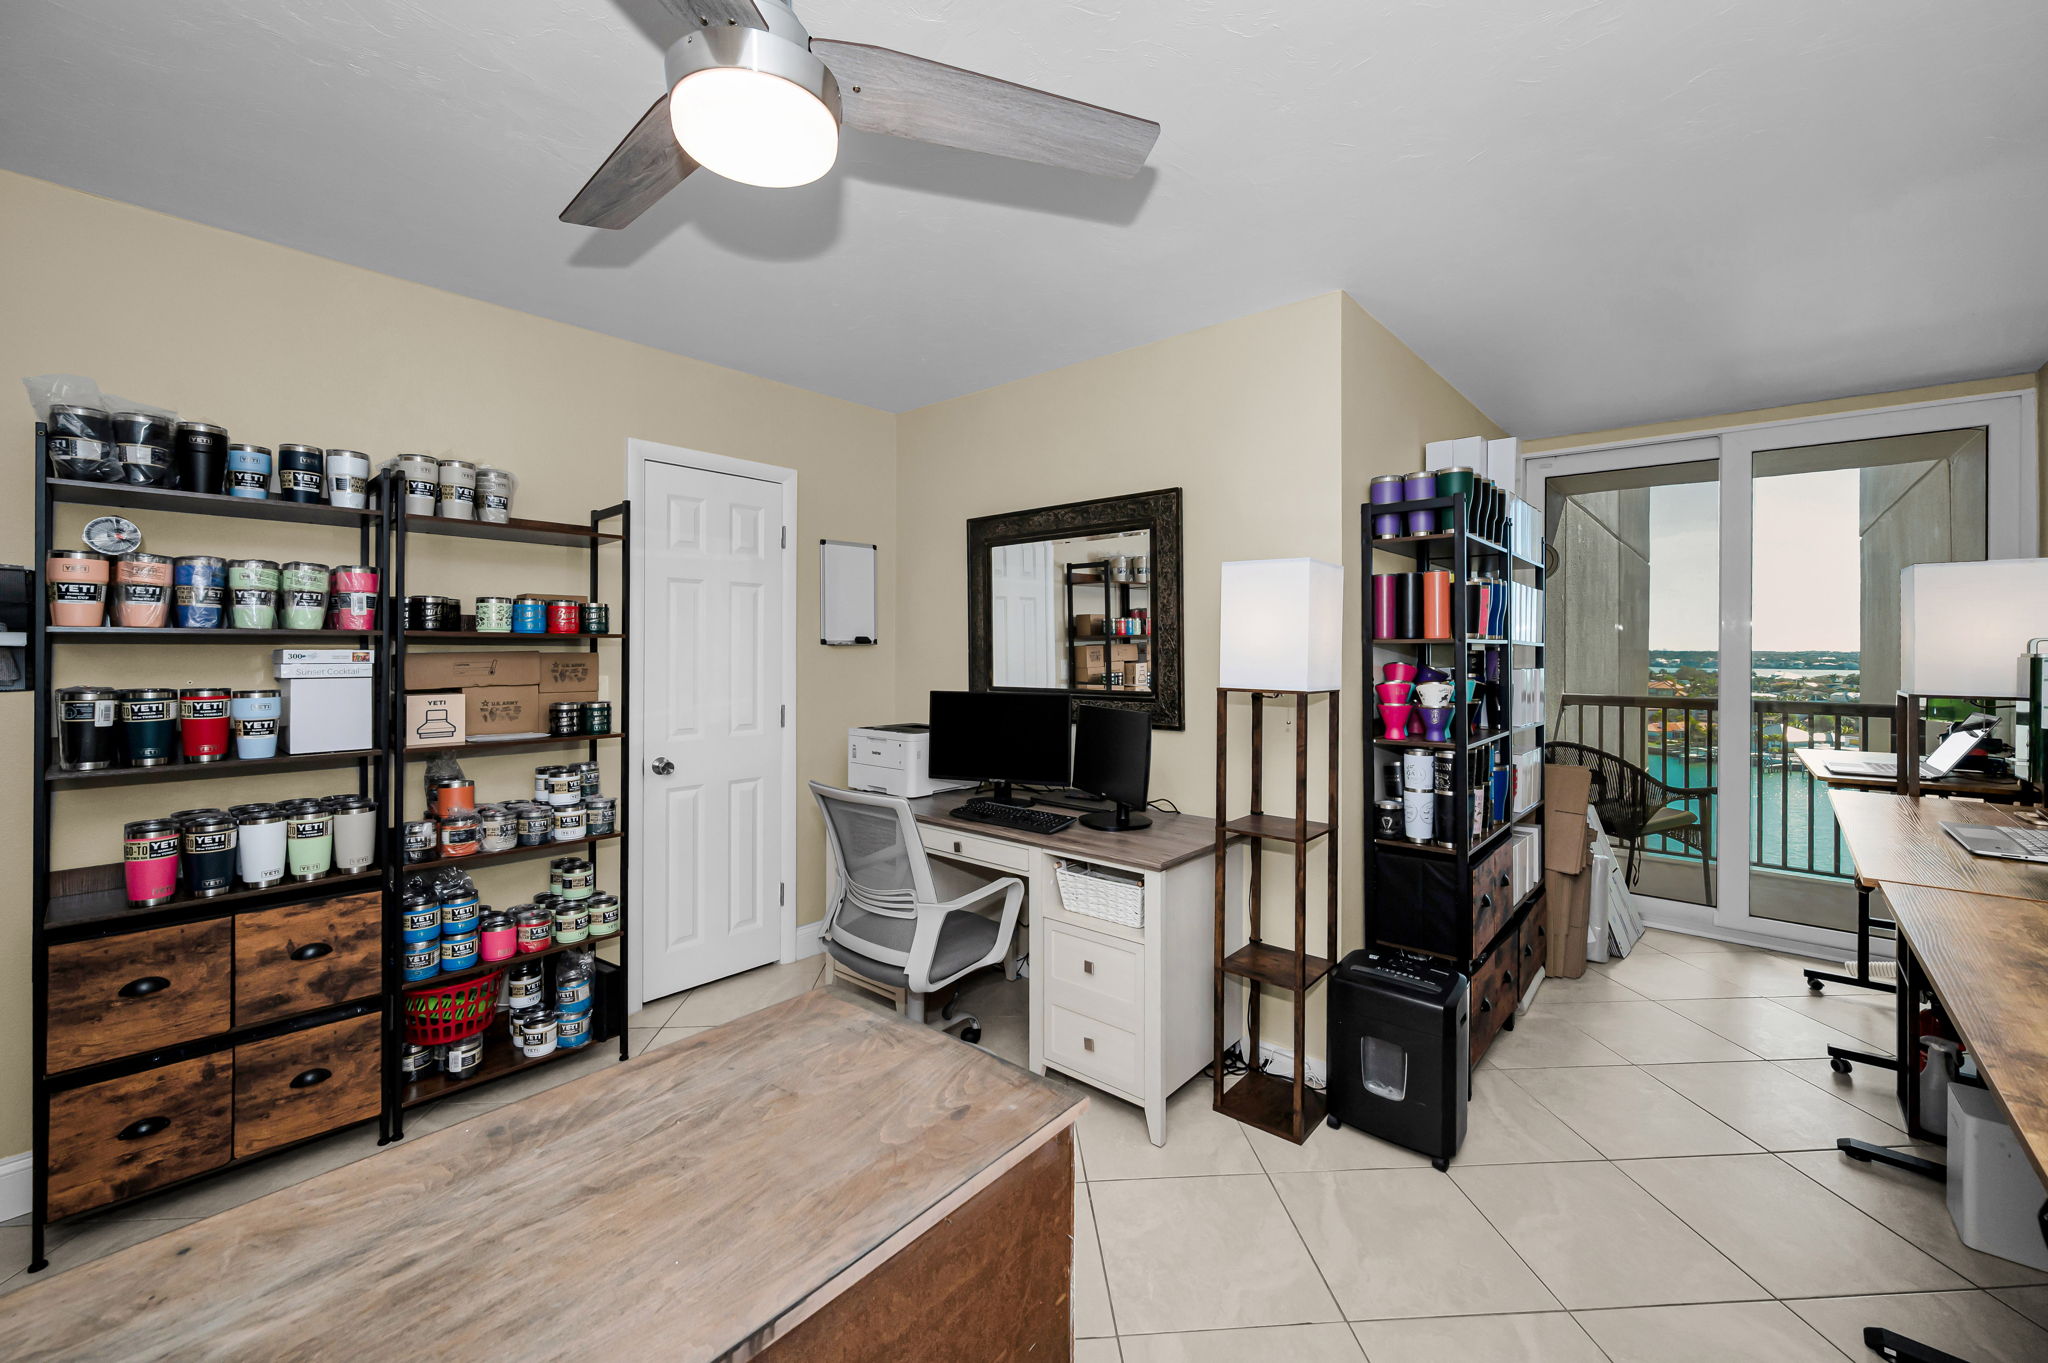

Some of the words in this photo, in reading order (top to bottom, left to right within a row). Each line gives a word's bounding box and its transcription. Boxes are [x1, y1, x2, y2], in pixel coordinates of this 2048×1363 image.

[191, 436, 211, 444] YETI
[235, 472, 263, 481] YETI
[294, 473, 319, 483] YETI
[410, 481, 434, 490] YETI
[457, 487, 474, 496] YETI
[486, 495, 507, 504] YETI
[58, 584, 95, 592] YETI
[126, 586, 160, 594] YETI
[235, 590, 266, 598] YETI
[294, 592, 322, 600] YETI
[295, 668, 325, 676] Sunset
[131, 703, 163, 712] YETI
[193, 702, 223, 710] YETI
[244, 721, 273, 729] YETI
[297, 822, 323, 831] YETI
[195, 834, 225, 844] YETI
[151, 839, 178, 850] YETI
[453, 906, 473, 915] YETI
[412, 913, 433, 922] YETI
[531, 925, 549, 934] YETI
[453, 942, 473, 951] YETI
[408, 954, 429, 962] YETI
[561, 1023, 578, 1031] YETI
